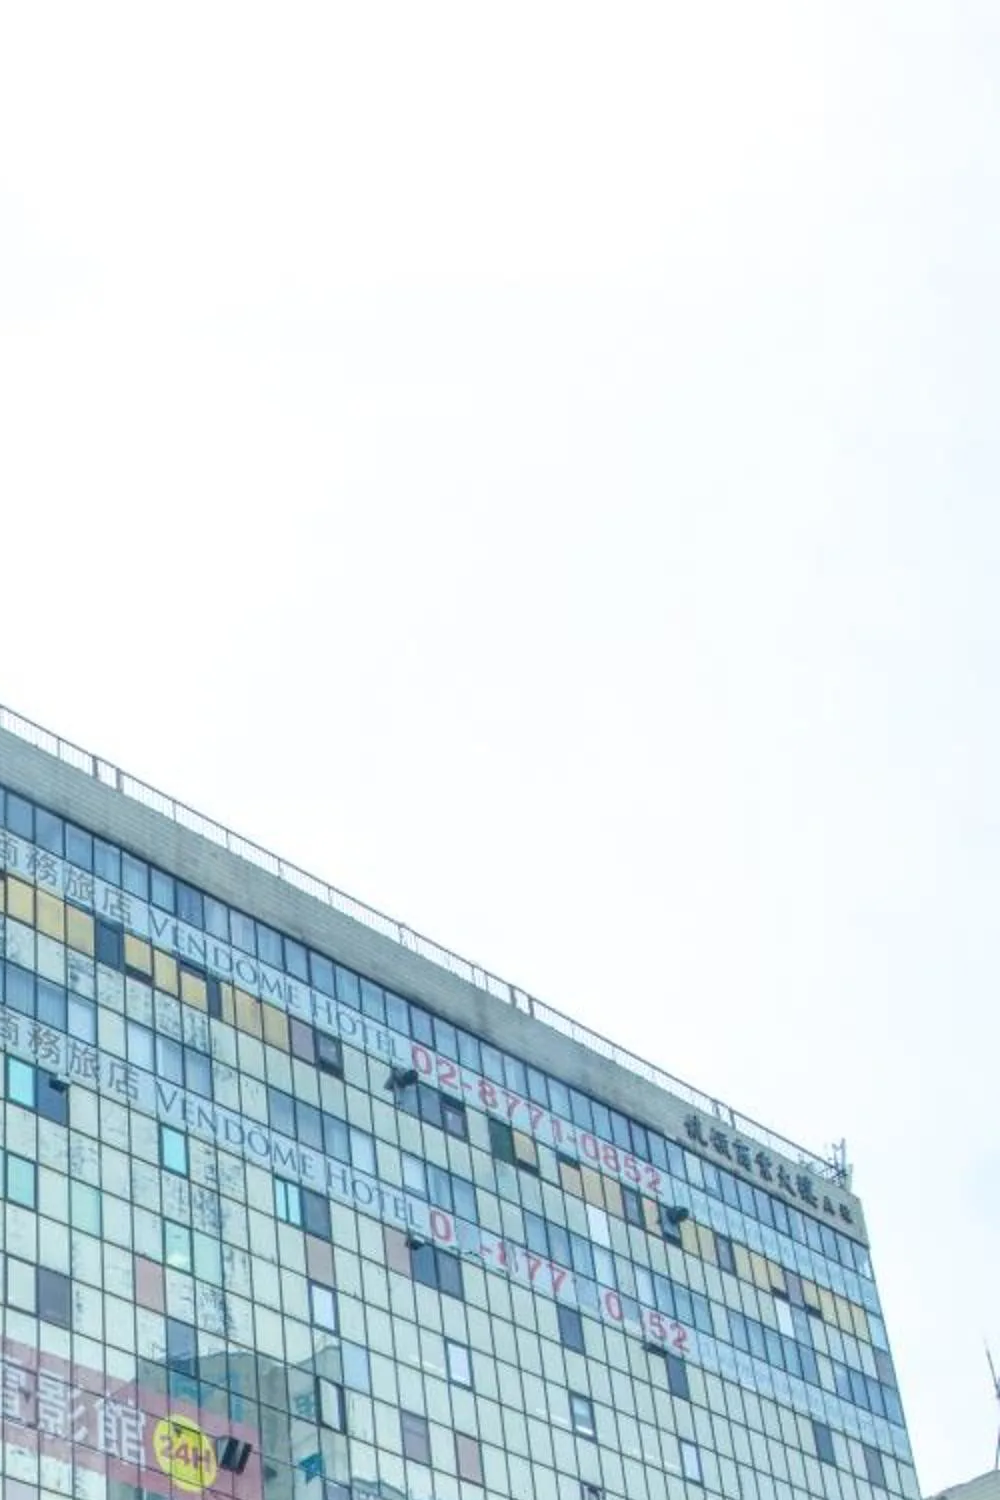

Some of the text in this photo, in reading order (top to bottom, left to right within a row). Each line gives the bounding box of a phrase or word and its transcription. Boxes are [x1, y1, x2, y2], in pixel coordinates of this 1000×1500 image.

[150, 911, 403, 1060] VENDOME HOTEL
[155, 1081, 425, 1227] VENDOME HOTEL
[411, 1046, 664, 1196] 02-8771-0852
[160, 1432, 215, 1473] 24H
